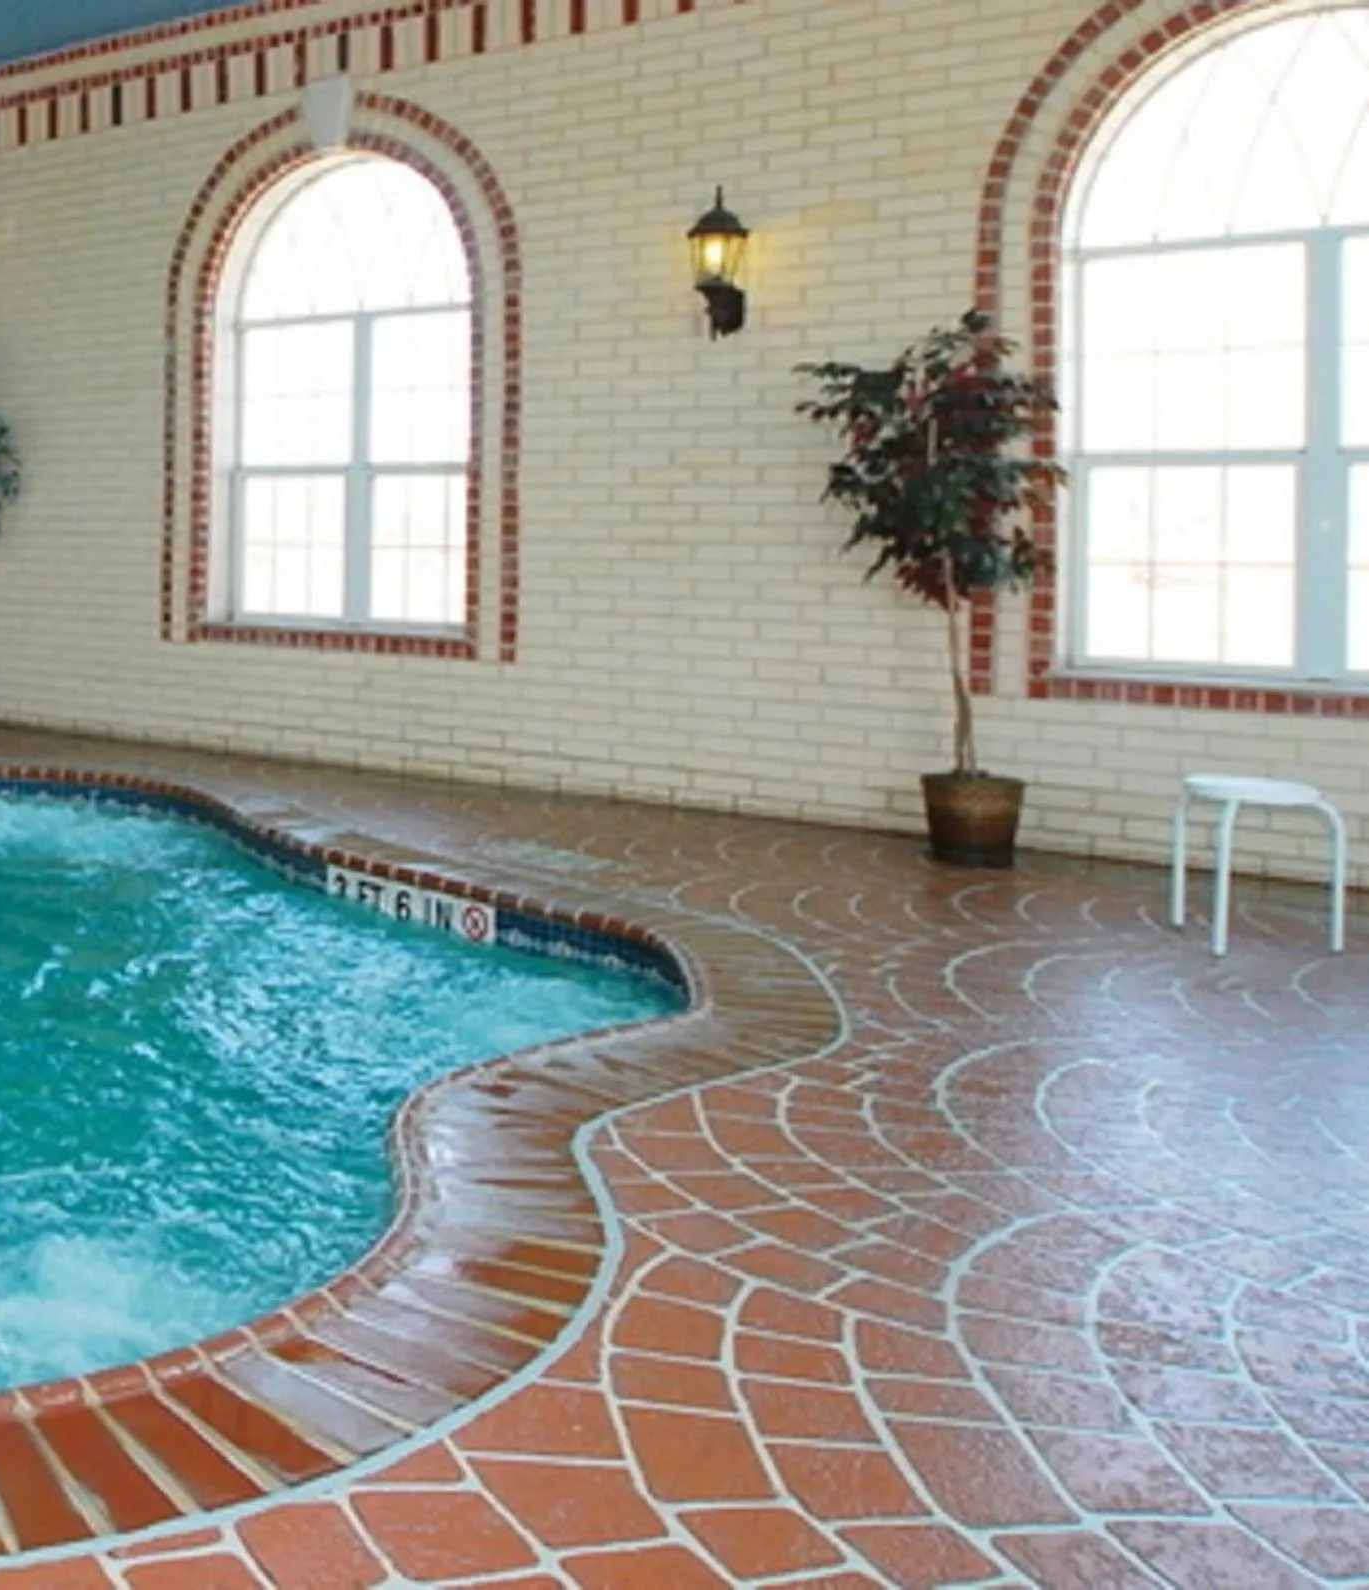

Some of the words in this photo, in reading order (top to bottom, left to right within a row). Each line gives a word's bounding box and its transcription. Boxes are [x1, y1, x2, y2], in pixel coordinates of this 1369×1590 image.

[358, 880, 384, 911] FT
[396, 890, 411, 920] 6
[424, 897, 453, 931] IN
